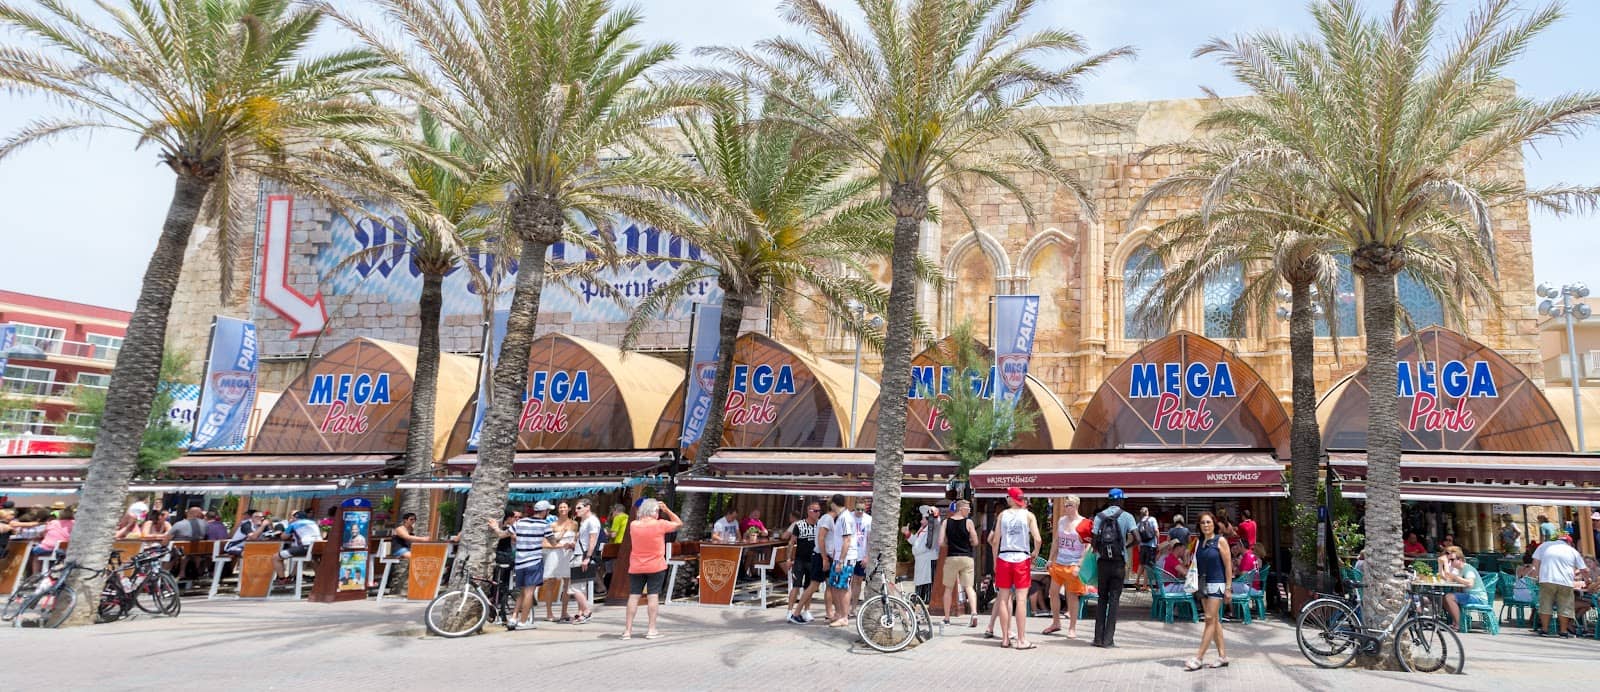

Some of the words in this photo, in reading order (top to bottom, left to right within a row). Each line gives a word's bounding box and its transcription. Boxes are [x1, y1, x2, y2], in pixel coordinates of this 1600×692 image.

[1016, 298, 1038, 353] PARK
[237, 325, 257, 371] PARK
[307, 373, 391, 405] MEGA
[521, 370, 591, 404] EGA
[729, 364, 796, 396] EGA
[1129, 361, 1237, 399] MEGA
[191, 401, 236, 448] MEGA
[321, 399, 369, 434] Park
[518, 397, 568, 434] Park
[683, 396, 711, 445] MEGA
[724, 390, 777, 426] Park
[1152, 391, 1214, 432] Park
[1408, 390, 1476, 432] Park
